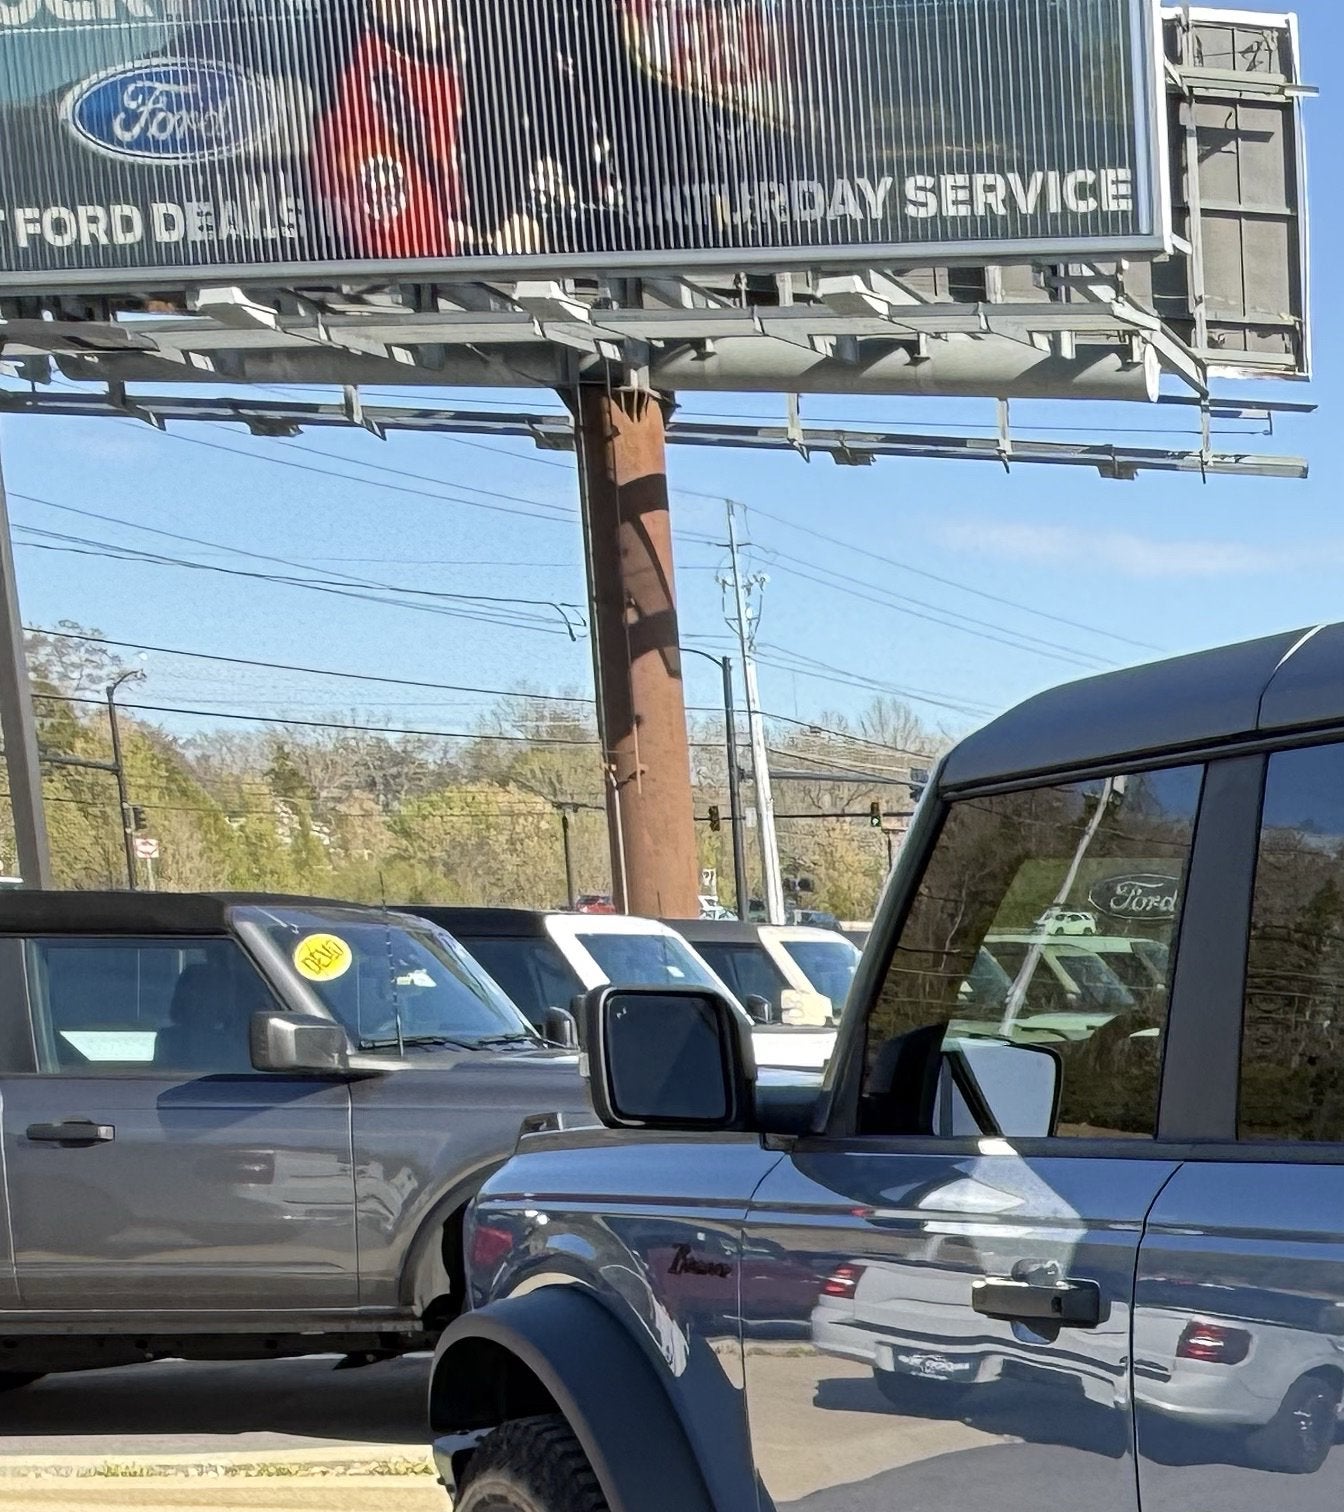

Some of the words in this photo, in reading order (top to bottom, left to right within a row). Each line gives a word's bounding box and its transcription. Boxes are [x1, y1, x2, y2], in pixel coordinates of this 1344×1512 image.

[113, 81, 231, 143] Ford
[904, 168, 1133, 218] SERVICE
[15, 204, 142, 247] FORD
